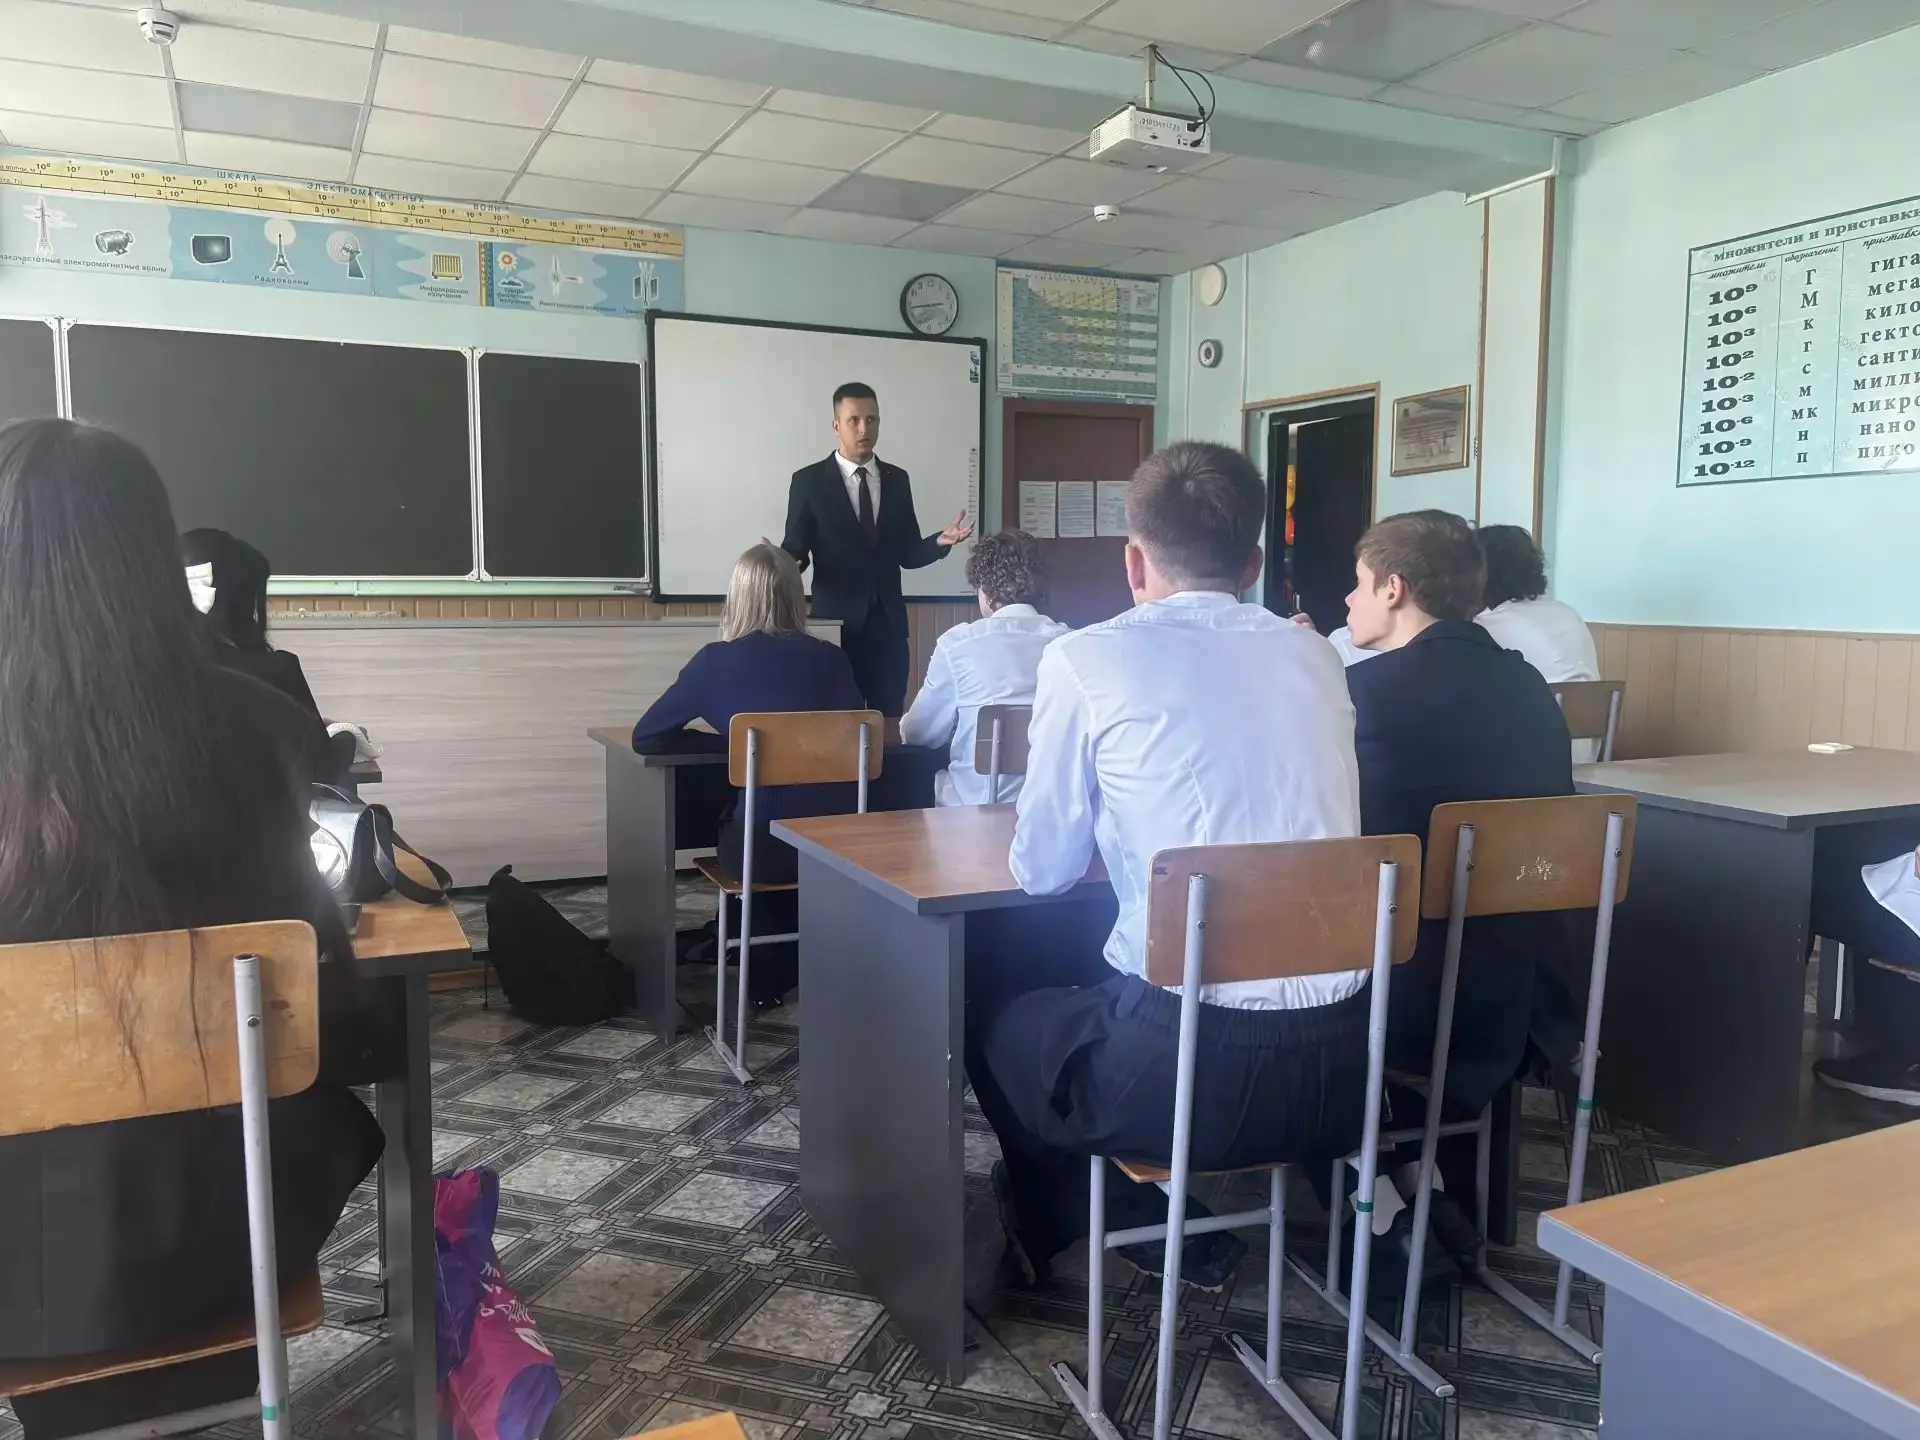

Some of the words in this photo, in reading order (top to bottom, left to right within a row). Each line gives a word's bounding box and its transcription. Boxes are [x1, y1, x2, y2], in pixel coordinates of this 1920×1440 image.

[216, 171, 257, 182] ШКАЛА
[1808, 230, 1820, 241] и
[1708, 262, 1768, 279] множители
[1870, 252, 1920, 273] гига
[254, 274, 309, 285] Радиоволны
[1868, 276, 1920, 296] мега
[1865, 300, 1920, 320] кило
[1858, 348, 1920, 367] санти
[1859, 419, 1915, 436] нано
[1858, 443, 1915, 459] пико
